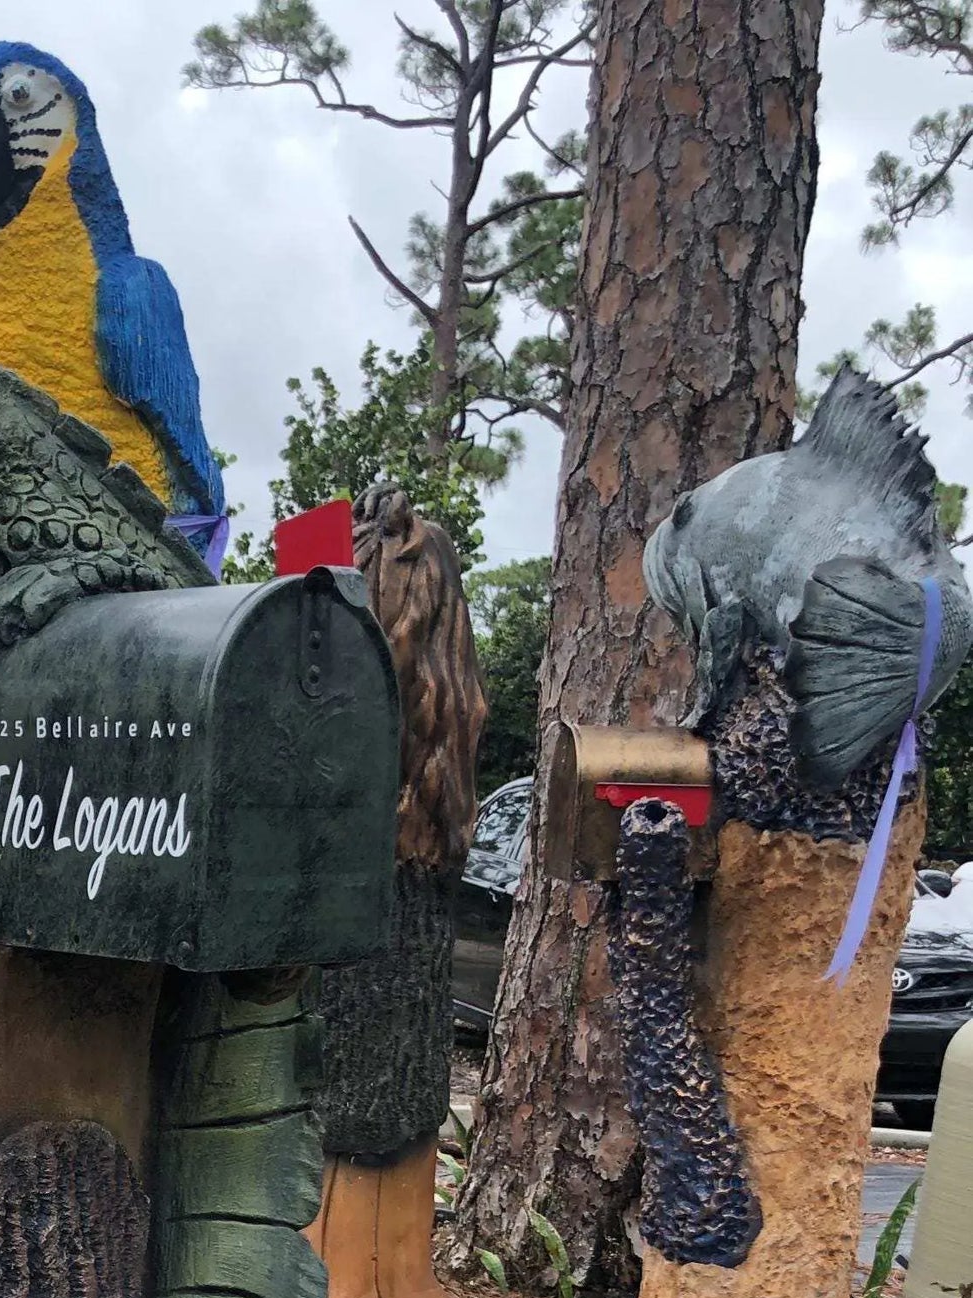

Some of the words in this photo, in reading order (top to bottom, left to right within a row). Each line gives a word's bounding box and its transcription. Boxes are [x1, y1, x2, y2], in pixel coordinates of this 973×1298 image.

[36, 716, 138, 739] Bellaire
[150, 720, 192, 739] Ave
[52, 765, 191, 901] Logans
